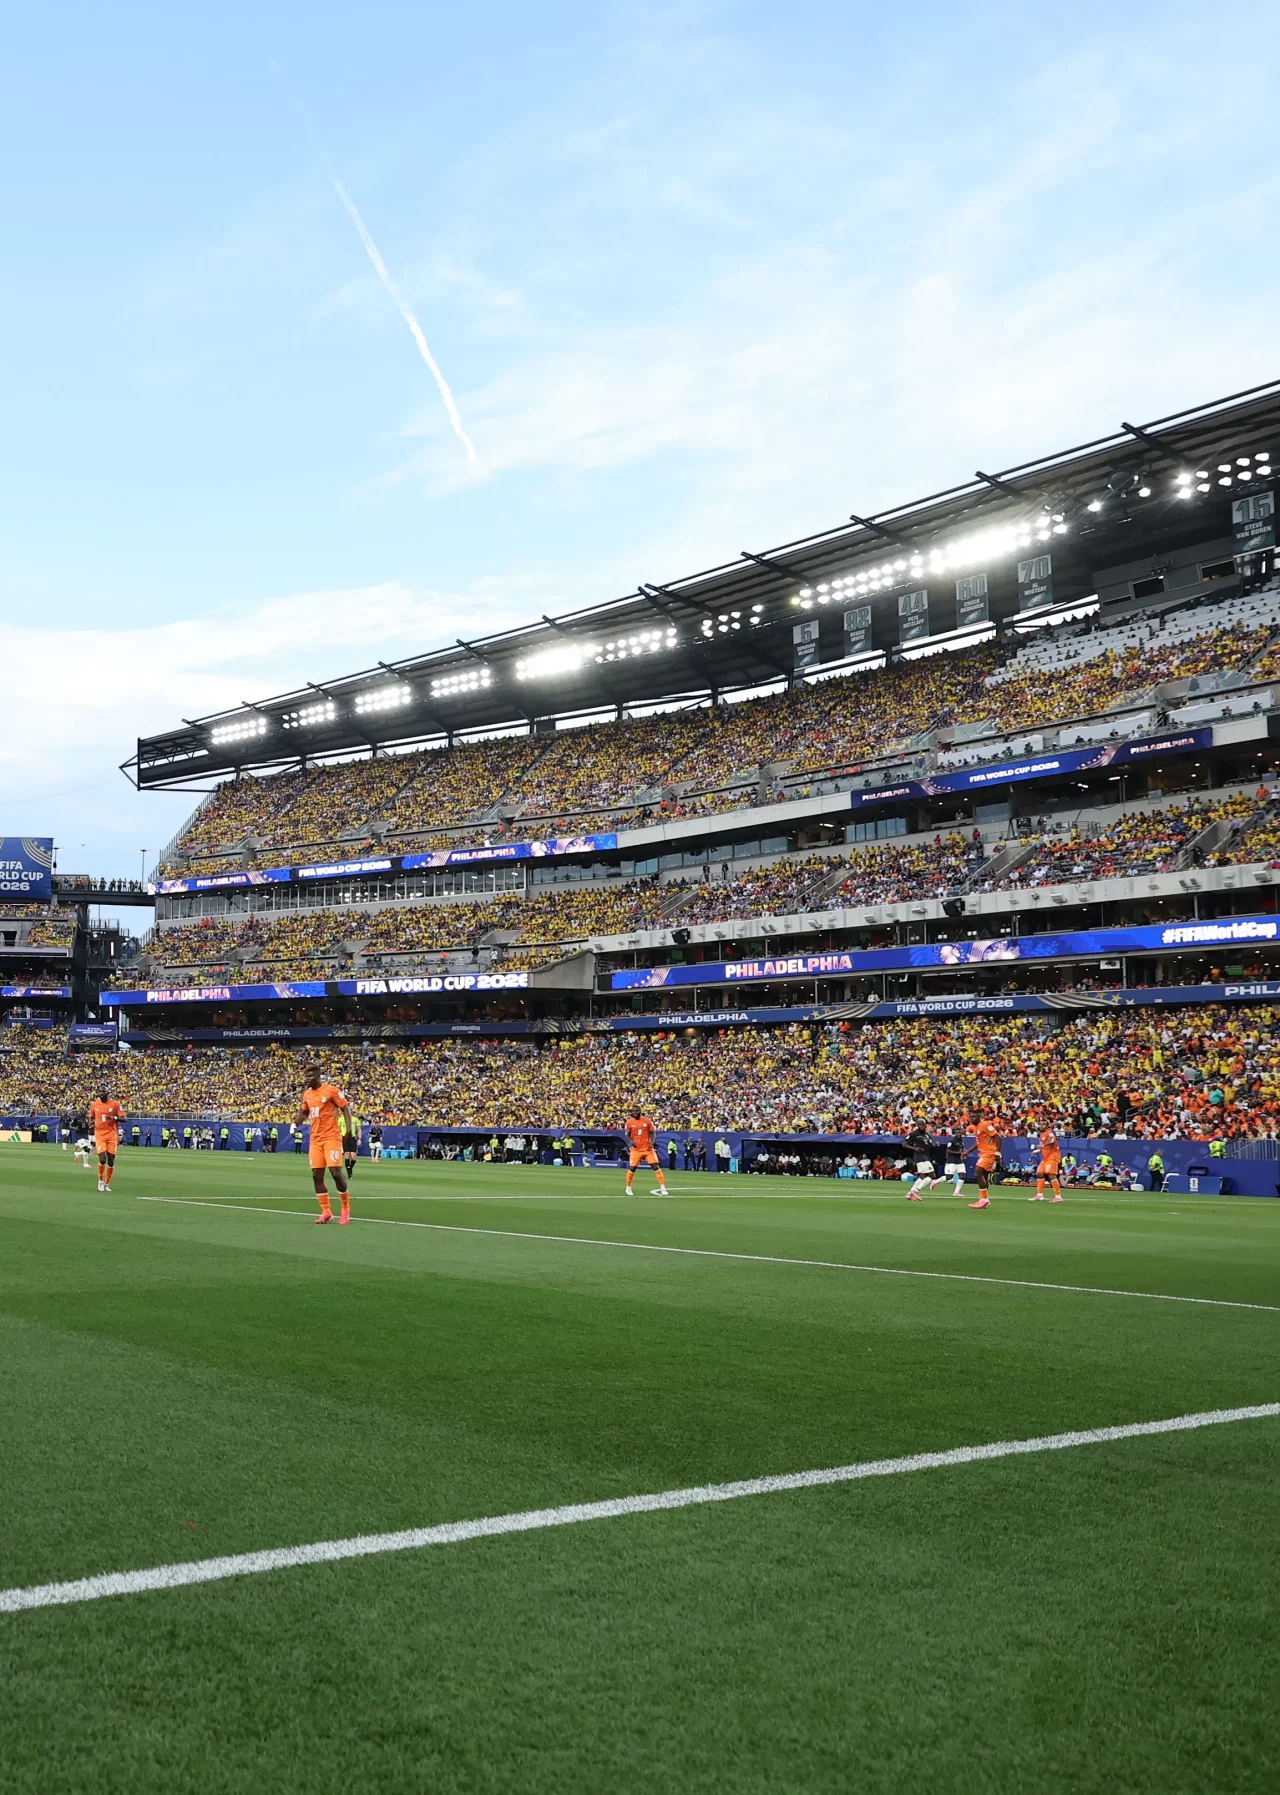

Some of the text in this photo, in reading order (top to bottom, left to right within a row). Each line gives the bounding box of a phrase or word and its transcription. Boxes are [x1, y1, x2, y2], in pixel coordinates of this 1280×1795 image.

[1236, 494, 1271, 524] 15
[1244, 521, 1264, 531] STEVE
[1236, 531, 1250, 539] VAN
[1022, 557, 1049, 583] 70
[960, 575, 986, 601] 60
[901, 592, 926, 616] 44
[846, 608, 870, 632] 92
[801, 624, 812, 644] 5
[1130, 737, 1195, 755] PHILADELPHIA
[970, 761, 1060, 784] FIFA WORLD CUP 2026
[862, 787, 910, 801] PHILADELPHIA
[451, 848, 515, 862] PHILADELPHIA
[0, 860, 24, 870] FIFA
[298, 860, 392, 877] FIFA WORLD CUP 2026
[20, 871, 44, 881] CUP
[196, 875, 247, 887] PHILADELPHIA
[1162, 921, 1278, 944] #FIFAWorldCup
[724, 955, 853, 979] PHILADELPHIA
[356, 982, 390, 994] FIFA
[389, 978, 444, 993] WORLD
[444, 976, 475, 990] CUP
[146, 987, 230, 1002] PHILADELPHIA
[896, 999, 1014, 1012] FIFA WORLD CUP 2026
[658, 1012, 749, 1025] PHILADELPHIA
[223, 1028, 291, 1037] PHILADELPHIA
